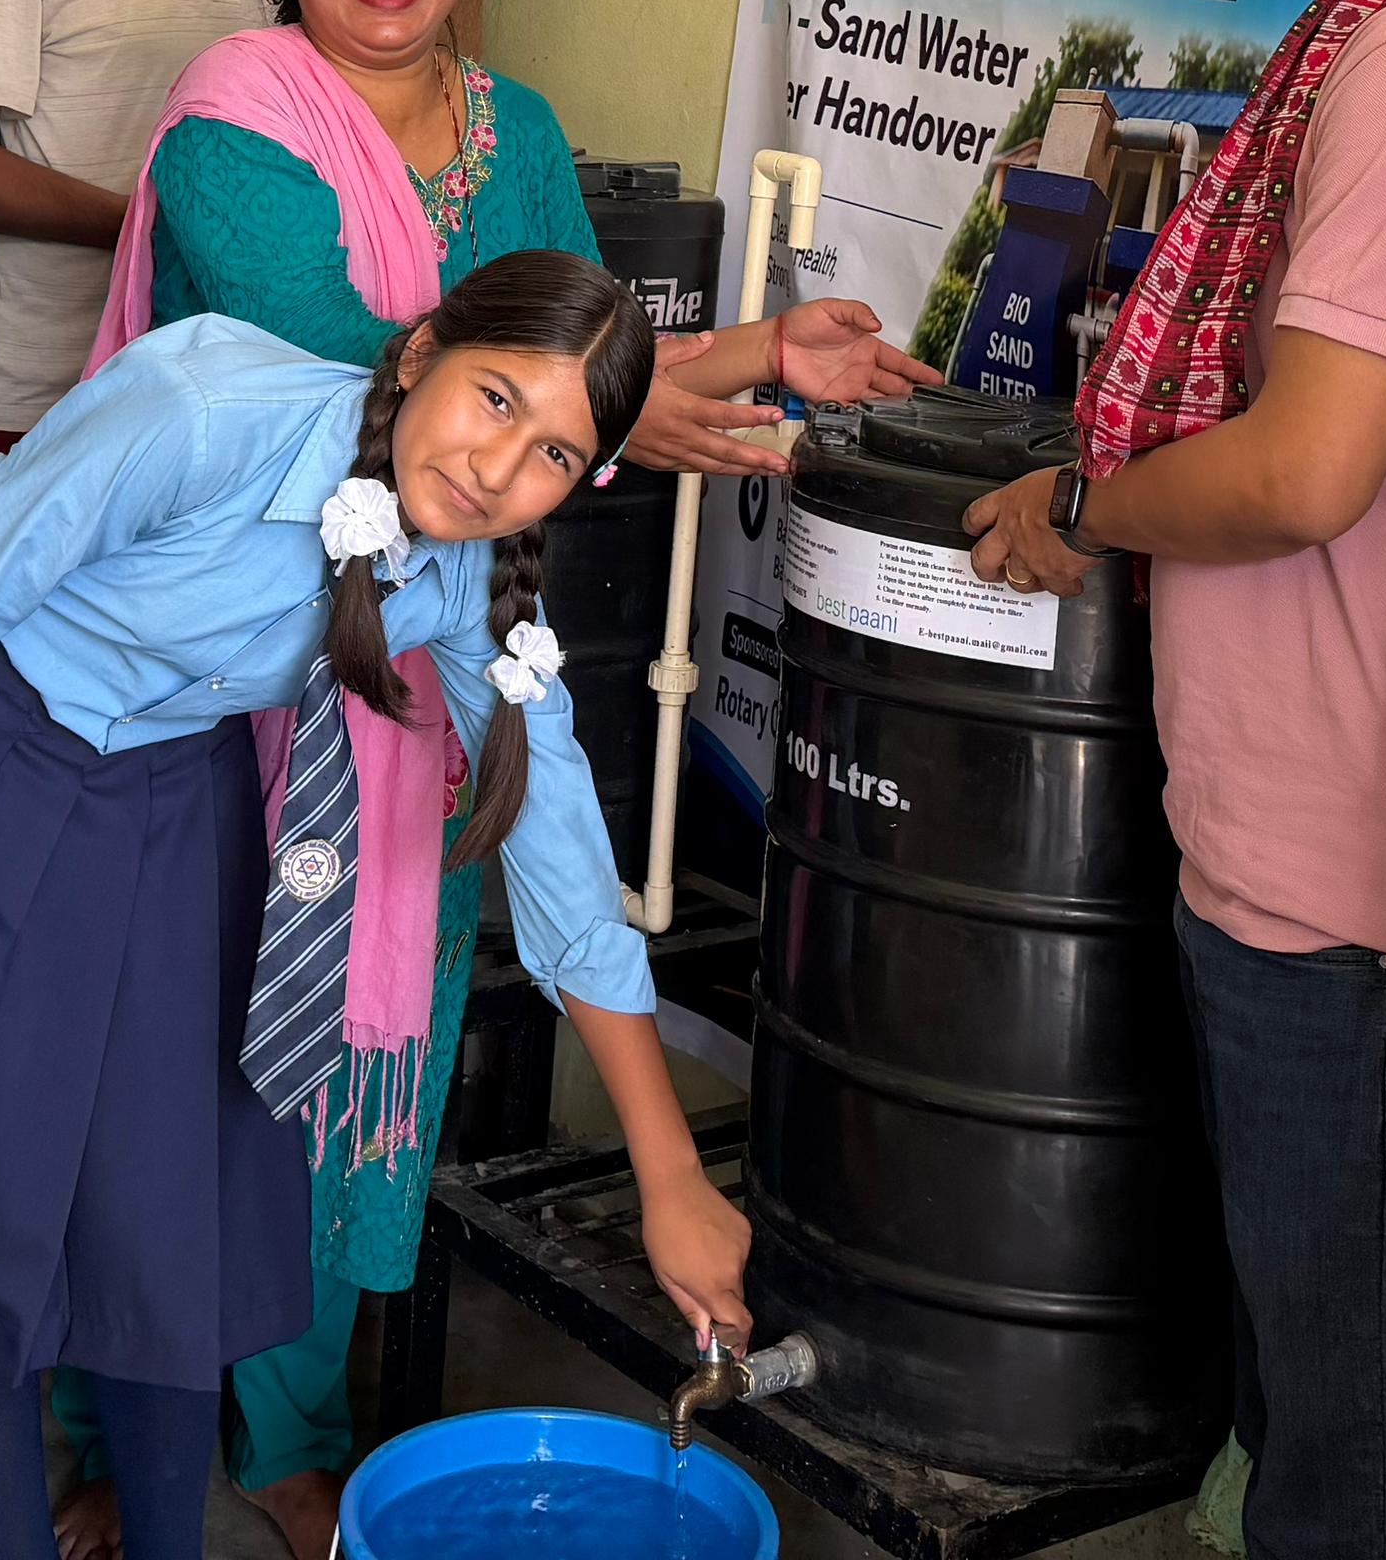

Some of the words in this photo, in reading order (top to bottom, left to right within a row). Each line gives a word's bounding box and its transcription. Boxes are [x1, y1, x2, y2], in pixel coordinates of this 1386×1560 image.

[919, 12, 1029, 89] Water
[813, 76, 997, 165] Handover
[1003, 292, 1031, 326] BIO
[986, 331, 1034, 370] SAND
[816, 587, 846, 620] best
[849, 603, 899, 634] paani
[729, 624, 779, 669] Sponsored
[715, 675, 768, 741] Rotary
[786, 730, 820, 780] 100
[828, 753, 911, 812] Ltrs.
